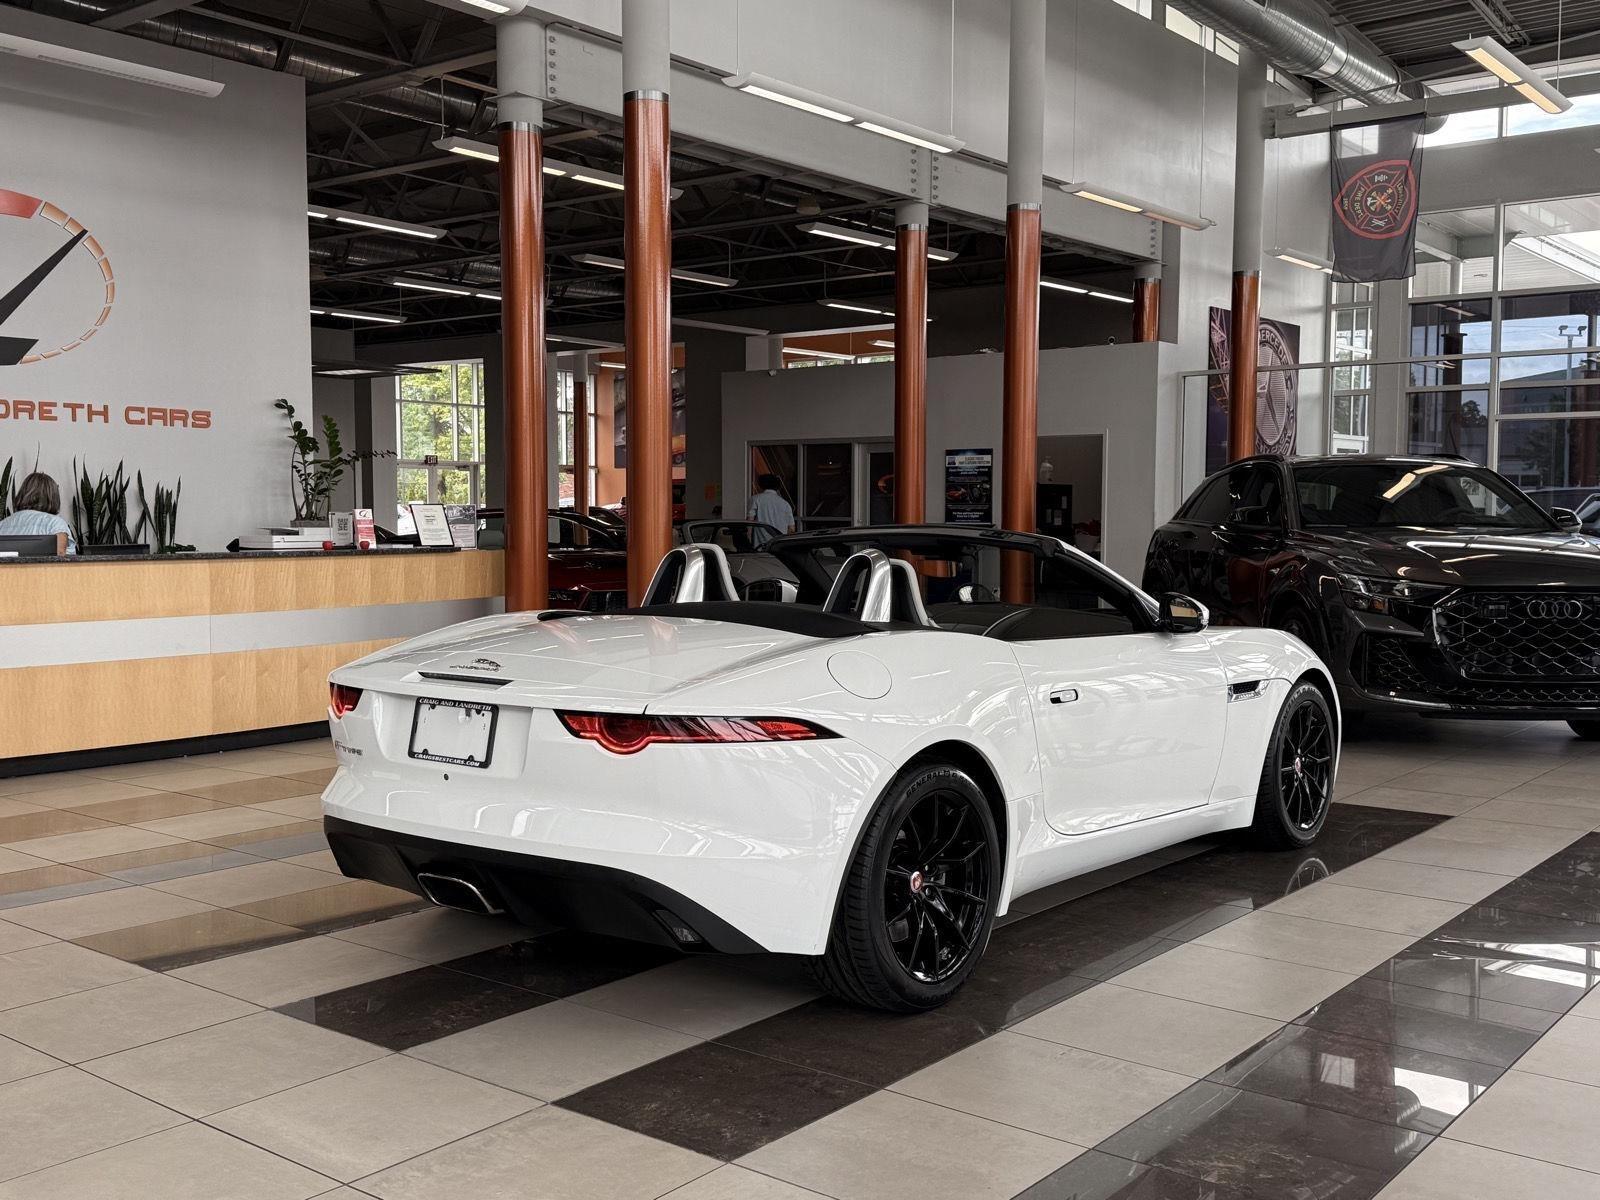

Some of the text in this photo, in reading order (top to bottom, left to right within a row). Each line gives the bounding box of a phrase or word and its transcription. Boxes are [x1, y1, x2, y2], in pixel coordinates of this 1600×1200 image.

[1354, 186, 1365, 201] FIRE
[124, 405, 212, 429] CARS
[419, 697, 439, 705] CRAIG
[455, 701, 492, 711] LANDRETH
[414, 753, 480, 767] CRAIGSBESTCARS.COM
